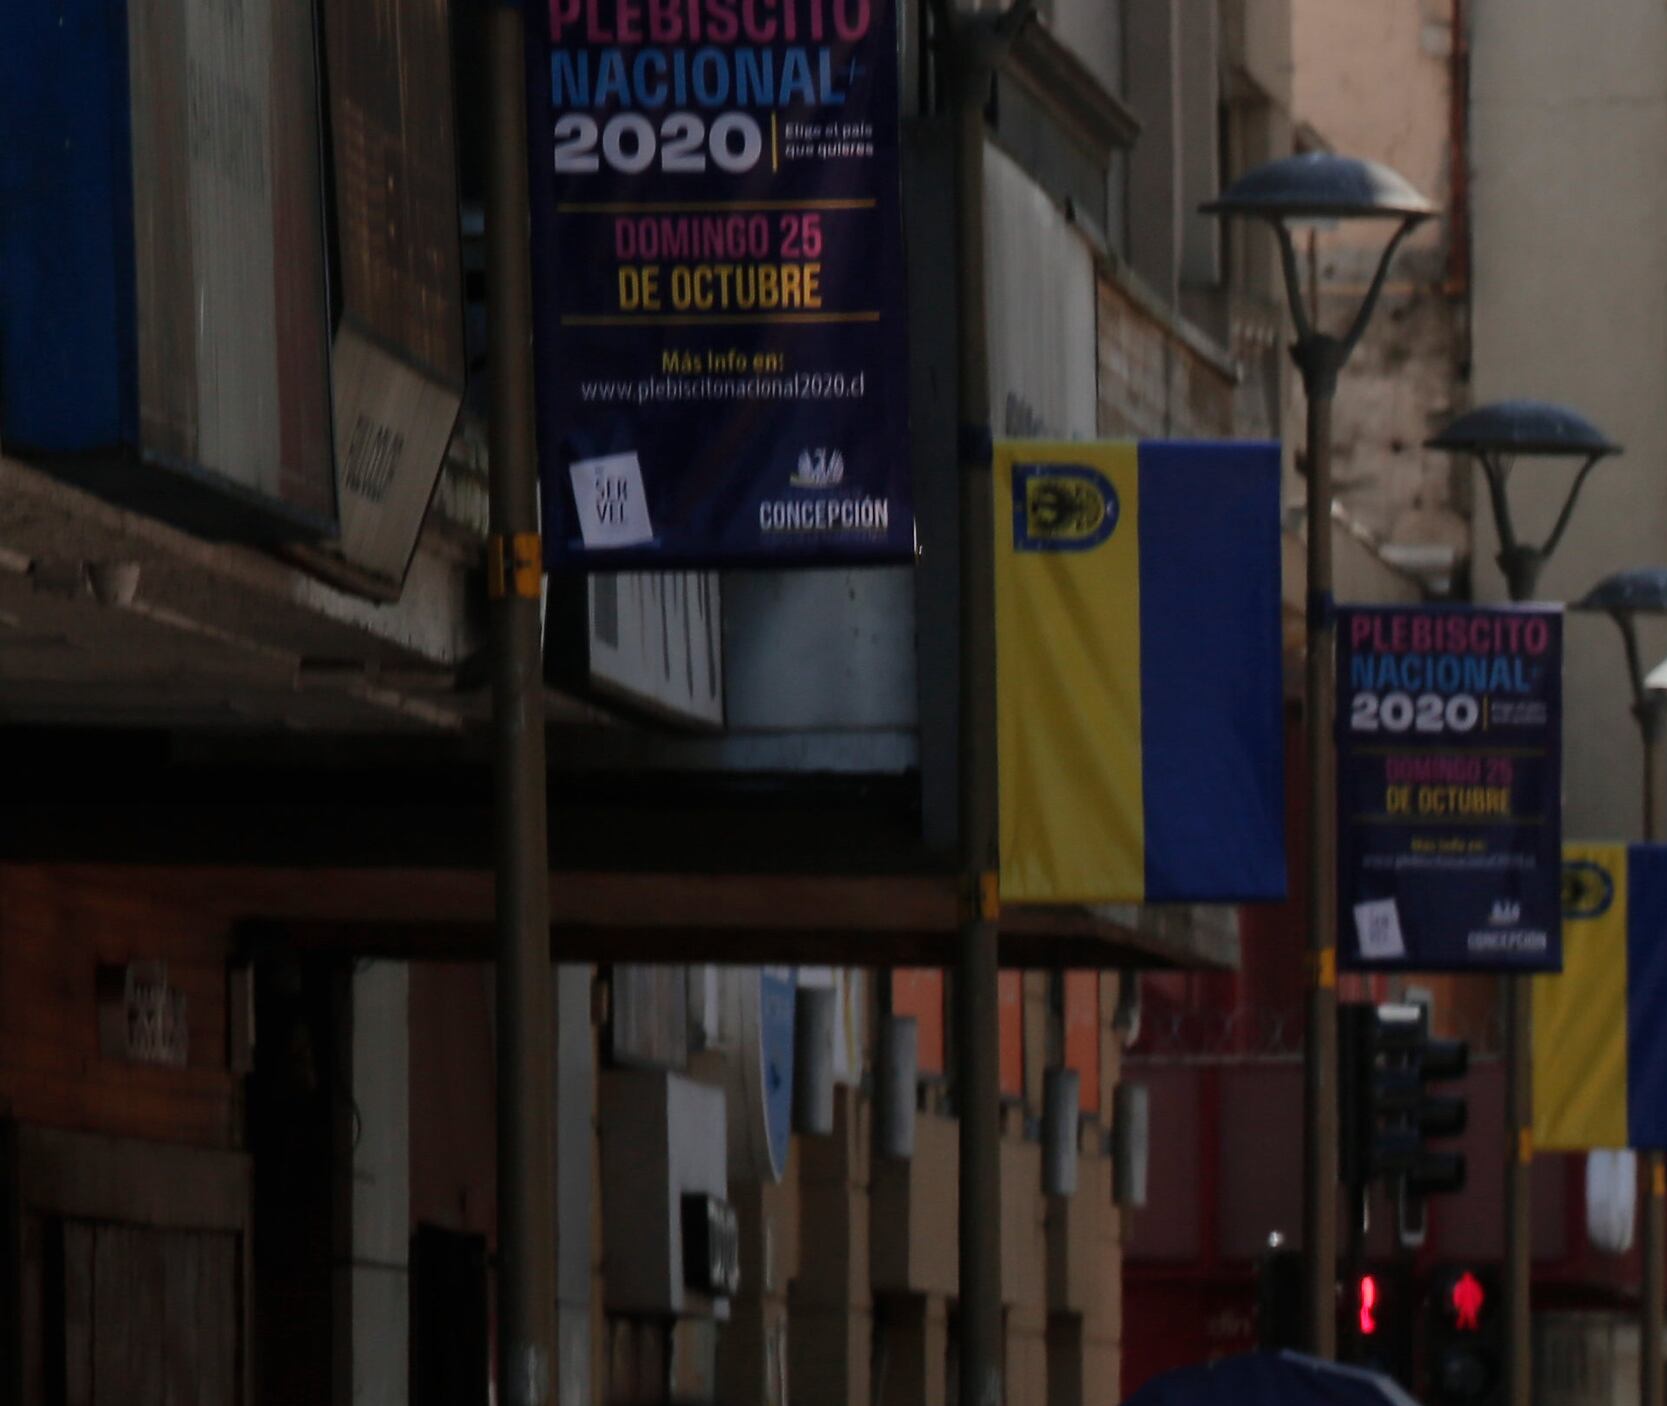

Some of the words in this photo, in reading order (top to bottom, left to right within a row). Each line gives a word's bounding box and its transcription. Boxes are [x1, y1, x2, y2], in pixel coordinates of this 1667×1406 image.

[549, 0, 870, 44] PLEBISCITO
[550, 46, 846, 108] NACIONAL
[553, 112, 762, 174] 2020
[614, 214, 769, 260] DOMINGO
[779, 212, 823, 258] 25
[618, 264, 660, 311] DE
[671, 260, 822, 310] OCTUBRE
[662, 349, 701, 373] Más
[759, 494, 889, 530] CONCEPCIÓN
[1351, 614, 1547, 655] PLEBISCITO
[1351, 652, 1530, 692] NACIONAL
[1351, 691, 1479, 732] 2020
